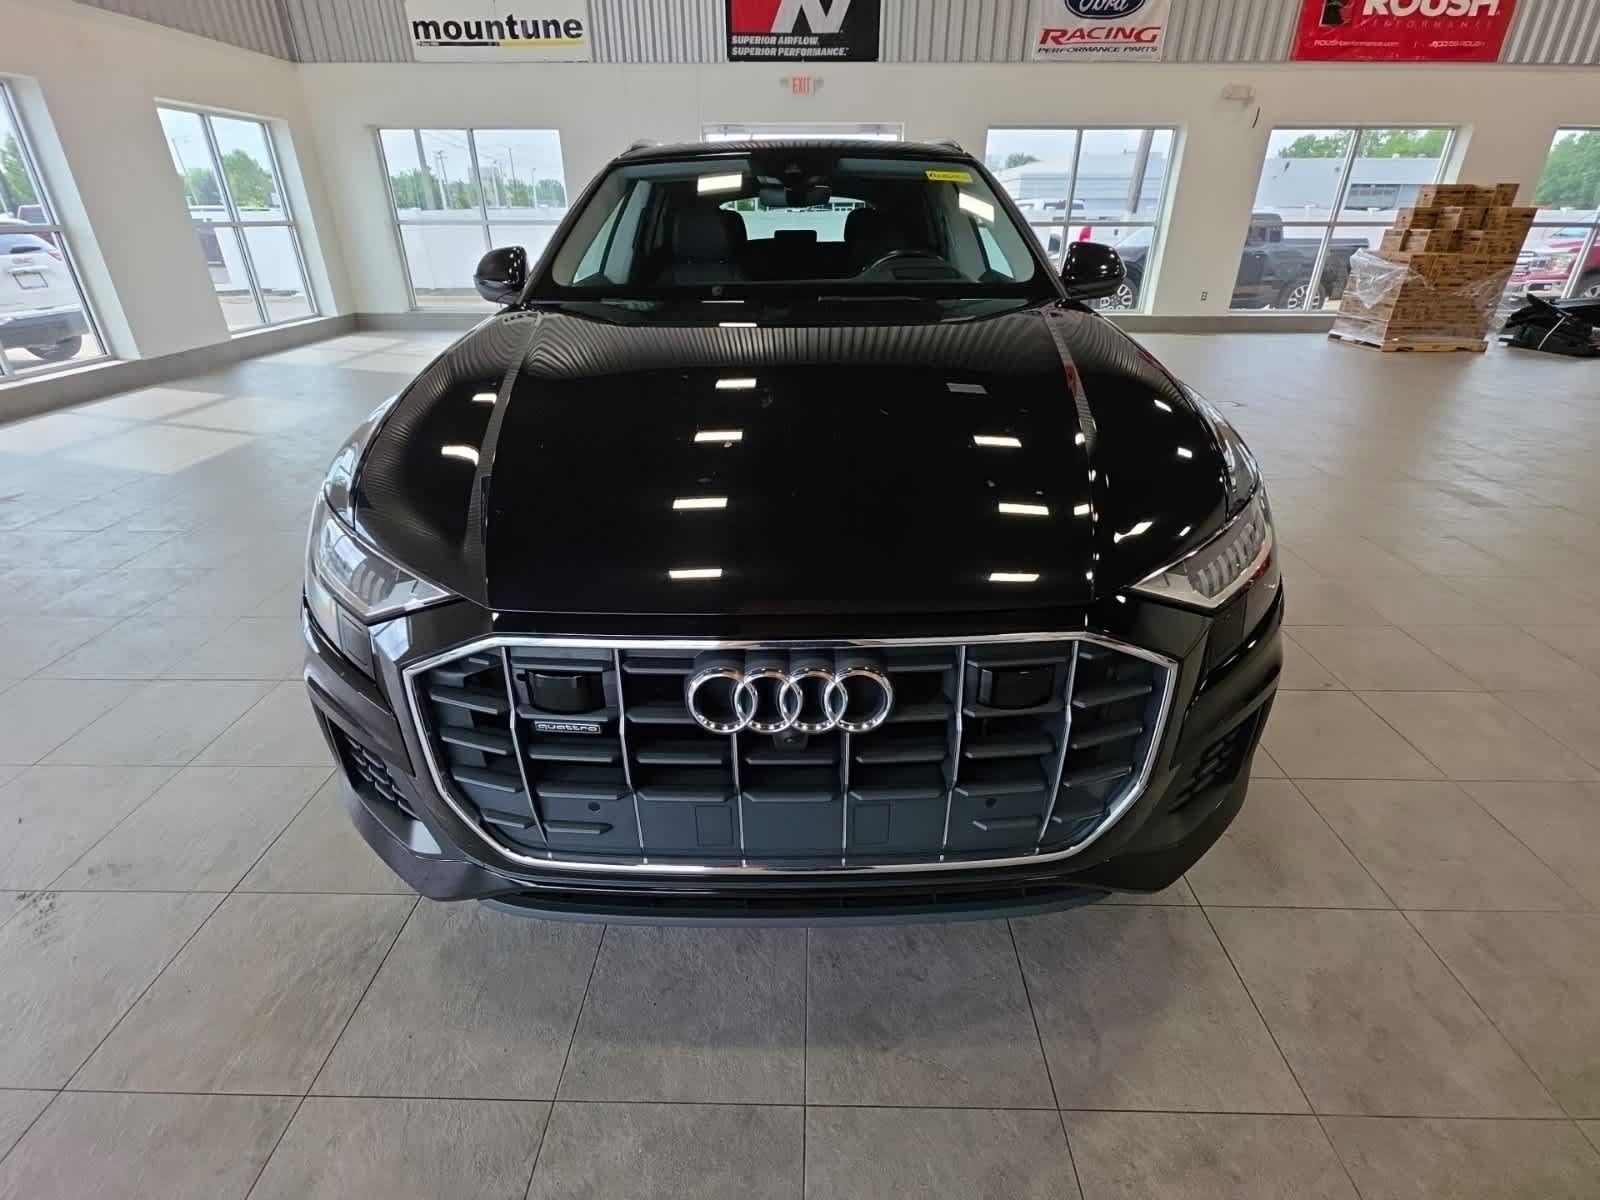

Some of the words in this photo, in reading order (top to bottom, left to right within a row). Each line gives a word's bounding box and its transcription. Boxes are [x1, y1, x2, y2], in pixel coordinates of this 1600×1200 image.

[1362, 0, 1500, 17] ROUSH
[412, 14, 584, 40] mountune
[731, 36, 777, 45] SUPERIOR
[1040, 27, 1161, 45] RACING
[731, 47, 777, 56] SUPERIOR
[537, 723, 598, 732] quattro
